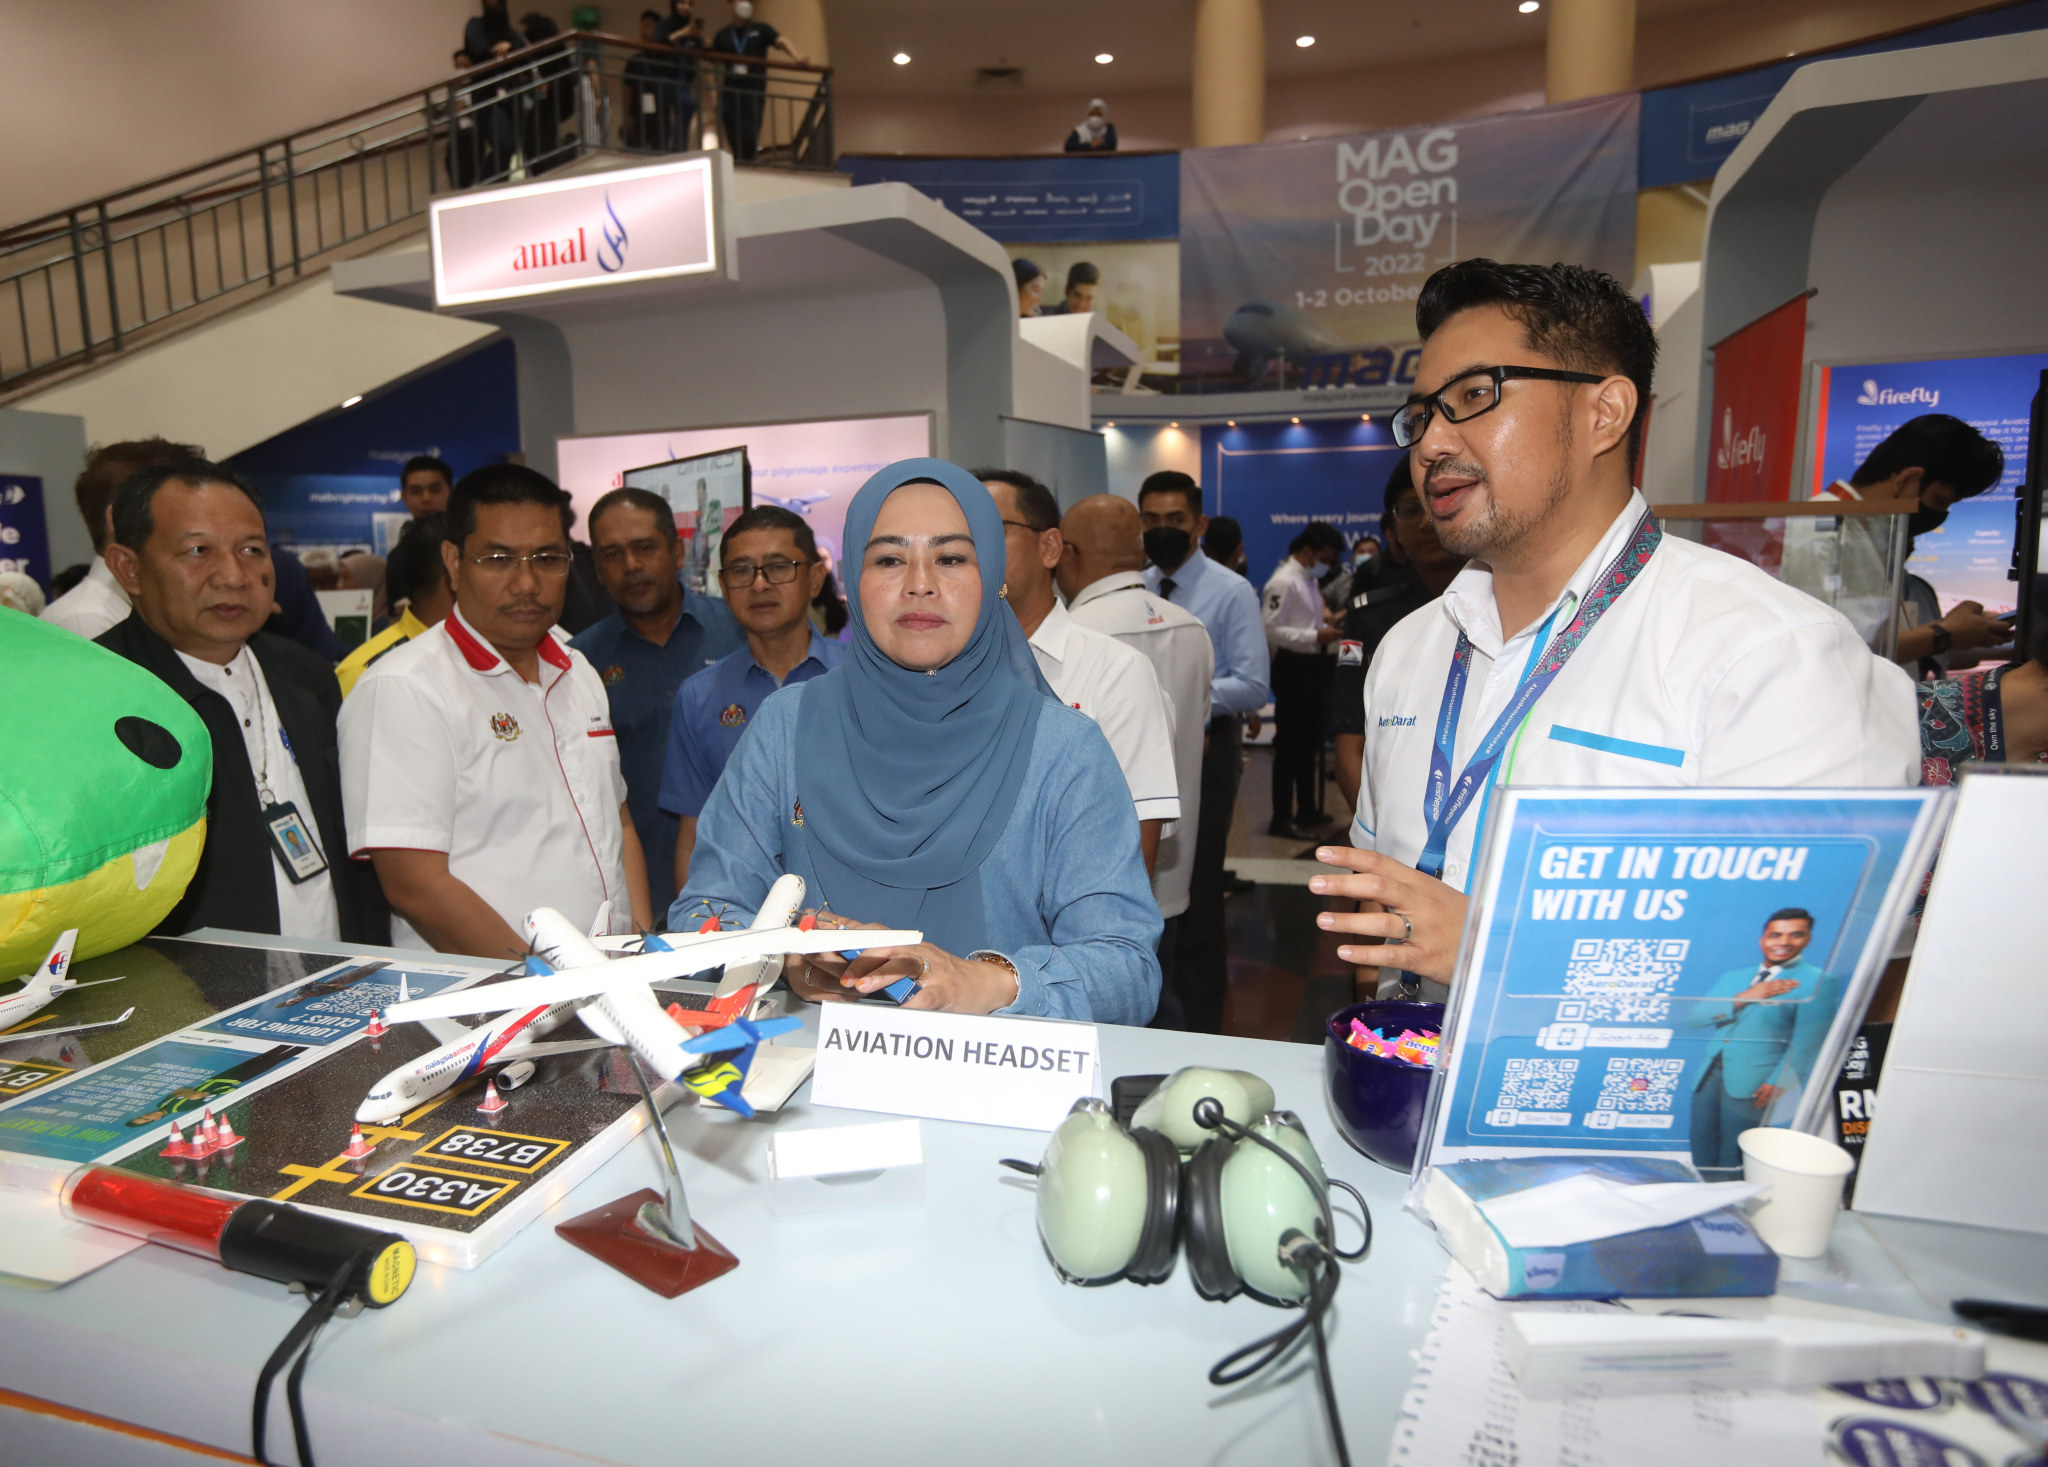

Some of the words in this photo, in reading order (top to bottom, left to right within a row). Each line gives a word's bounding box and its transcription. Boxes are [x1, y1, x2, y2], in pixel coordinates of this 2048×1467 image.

[1337, 129, 1458, 182] MAG
[1338, 176, 1457, 216] Open
[1354, 211, 1441, 249] Day
[513, 227, 587, 270] amal
[1365, 253, 1425, 277] 2022
[1295, 289, 1327, 309] 1-2
[1334, 283, 1420, 306] Octobe
[1879, 387, 1939, 408] firefly
[1442, 673, 1461, 745] #MalaysianHospitality
[1485, 683, 1538, 754] #MalaysianHospitality
[1988, 708, 1997, 721] sky
[1989, 721, 1997, 733] the
[1989, 734, 1998, 750] Own
[1432, 781, 1443, 821] malaysia
[1444, 788, 1468, 824] malaysia
[1539, 846, 1613, 879] GET
[1617, 846, 1663, 879] IN
[1671, 846, 1808, 880] TOUCH
[1531, 889, 1626, 920] WITH
[1633, 889, 1688, 920] US
[226, 1017, 264, 1029] FOR
[266, 1022, 342, 1037] LOOKING
[302, 1016, 362, 1028] CLUES
[824, 1028, 954, 1061] AVIATION
[963, 1040, 1090, 1074] HEADSET
[0, 1067, 50, 1086] B7
[1842, 1121, 1872, 1135] DIS
[439, 1134, 548, 1165] B738
[377, 1172, 503, 1206] A330
[391, 1247, 400, 1295] MAGNETIC
